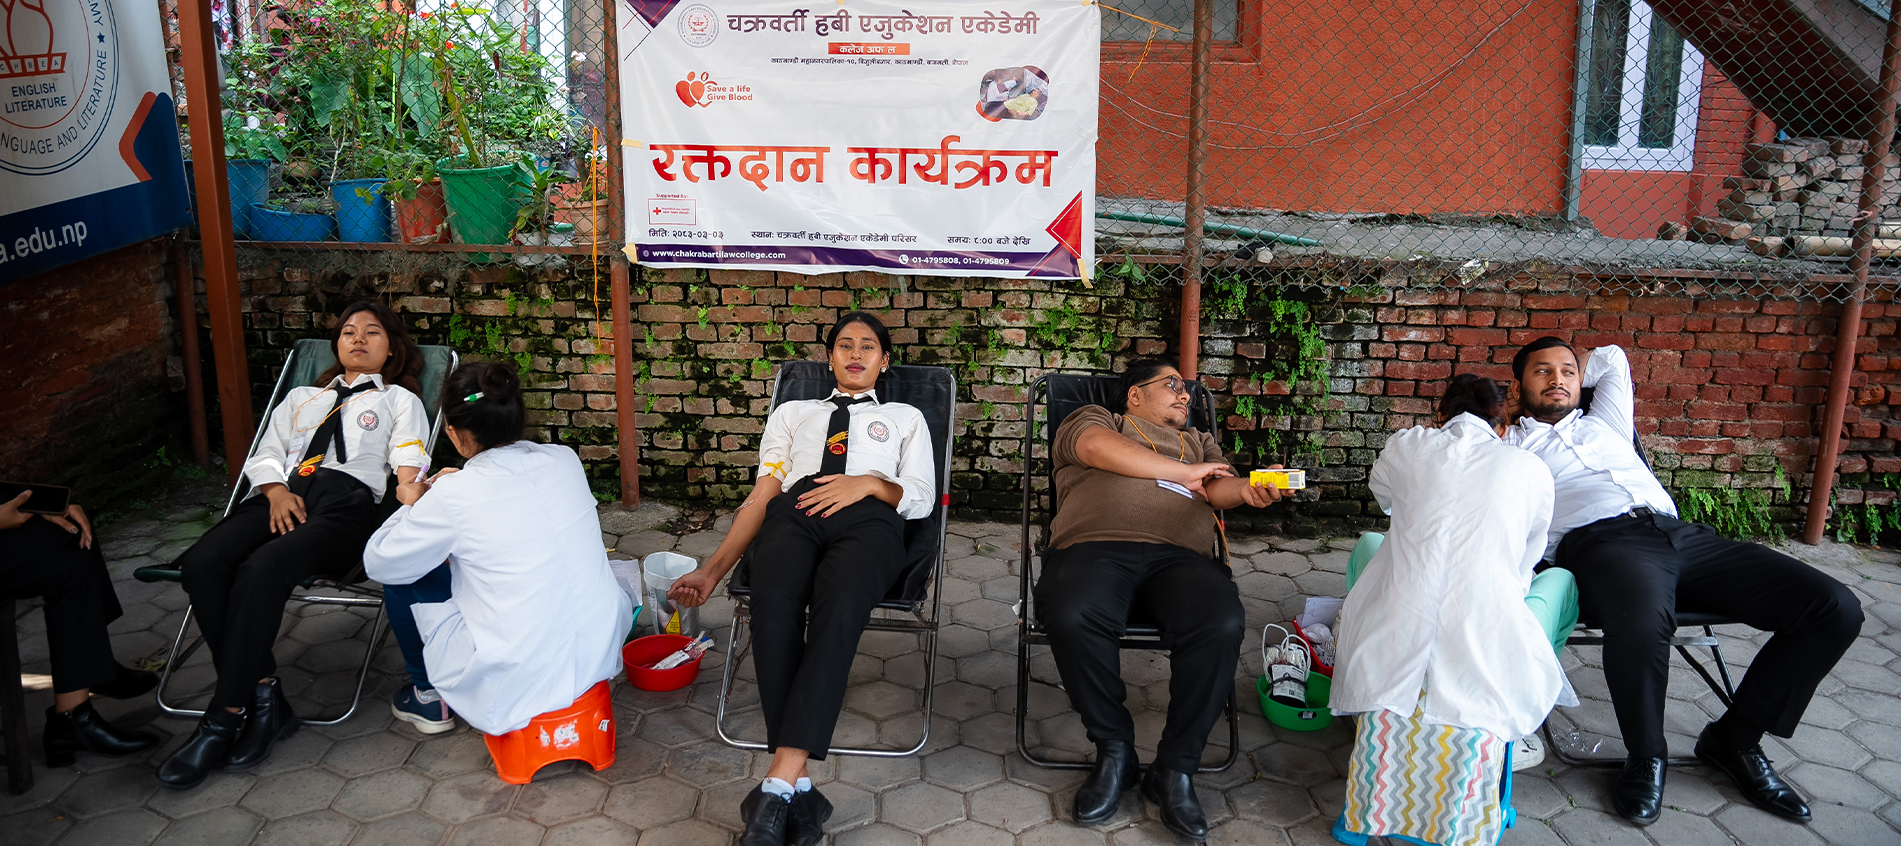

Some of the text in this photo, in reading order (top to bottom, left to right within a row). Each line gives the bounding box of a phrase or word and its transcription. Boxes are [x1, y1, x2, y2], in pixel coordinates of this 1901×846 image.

[88, 0, 104, 26] MY
[727, 9, 809, 33] चक्रवर्ती
[815, 9, 852, 37] हबी
[858, 9, 954, 41] एजुकेशन
[960, 10, 1040, 35] एकेडेमी
[839, 44, 864, 54] कलेज
[866, 45, 885, 54] अफ
[11, 82, 57, 98] ENGLISH
[737, 85, 751, 93] life
[57, 126, 78, 149] AND
[77, 49, 107, 131] LITERATURE
[707, 93, 753, 101] Give Blood
[5, 96, 68, 114] LITERATURE
[649, 135, 1059, 191] रक्तदान कार्यक्रम
[0, 220, 88, 265] a.edu.np
[776, 231, 807, 240] चक्रवर्ती
[808, 232, 821, 242] हबी
[823, 232, 858, 243] एजुकेशन
[860, 233, 889, 243] एकेडेमी
[891, 233, 918, 243] परिसर
[1012, 235, 1031, 246] देखि
[652, 250, 786, 259] www.chakrabartilawcollege.com
[911, 256, 1010, 265] 01-4795808, 01-4795809
